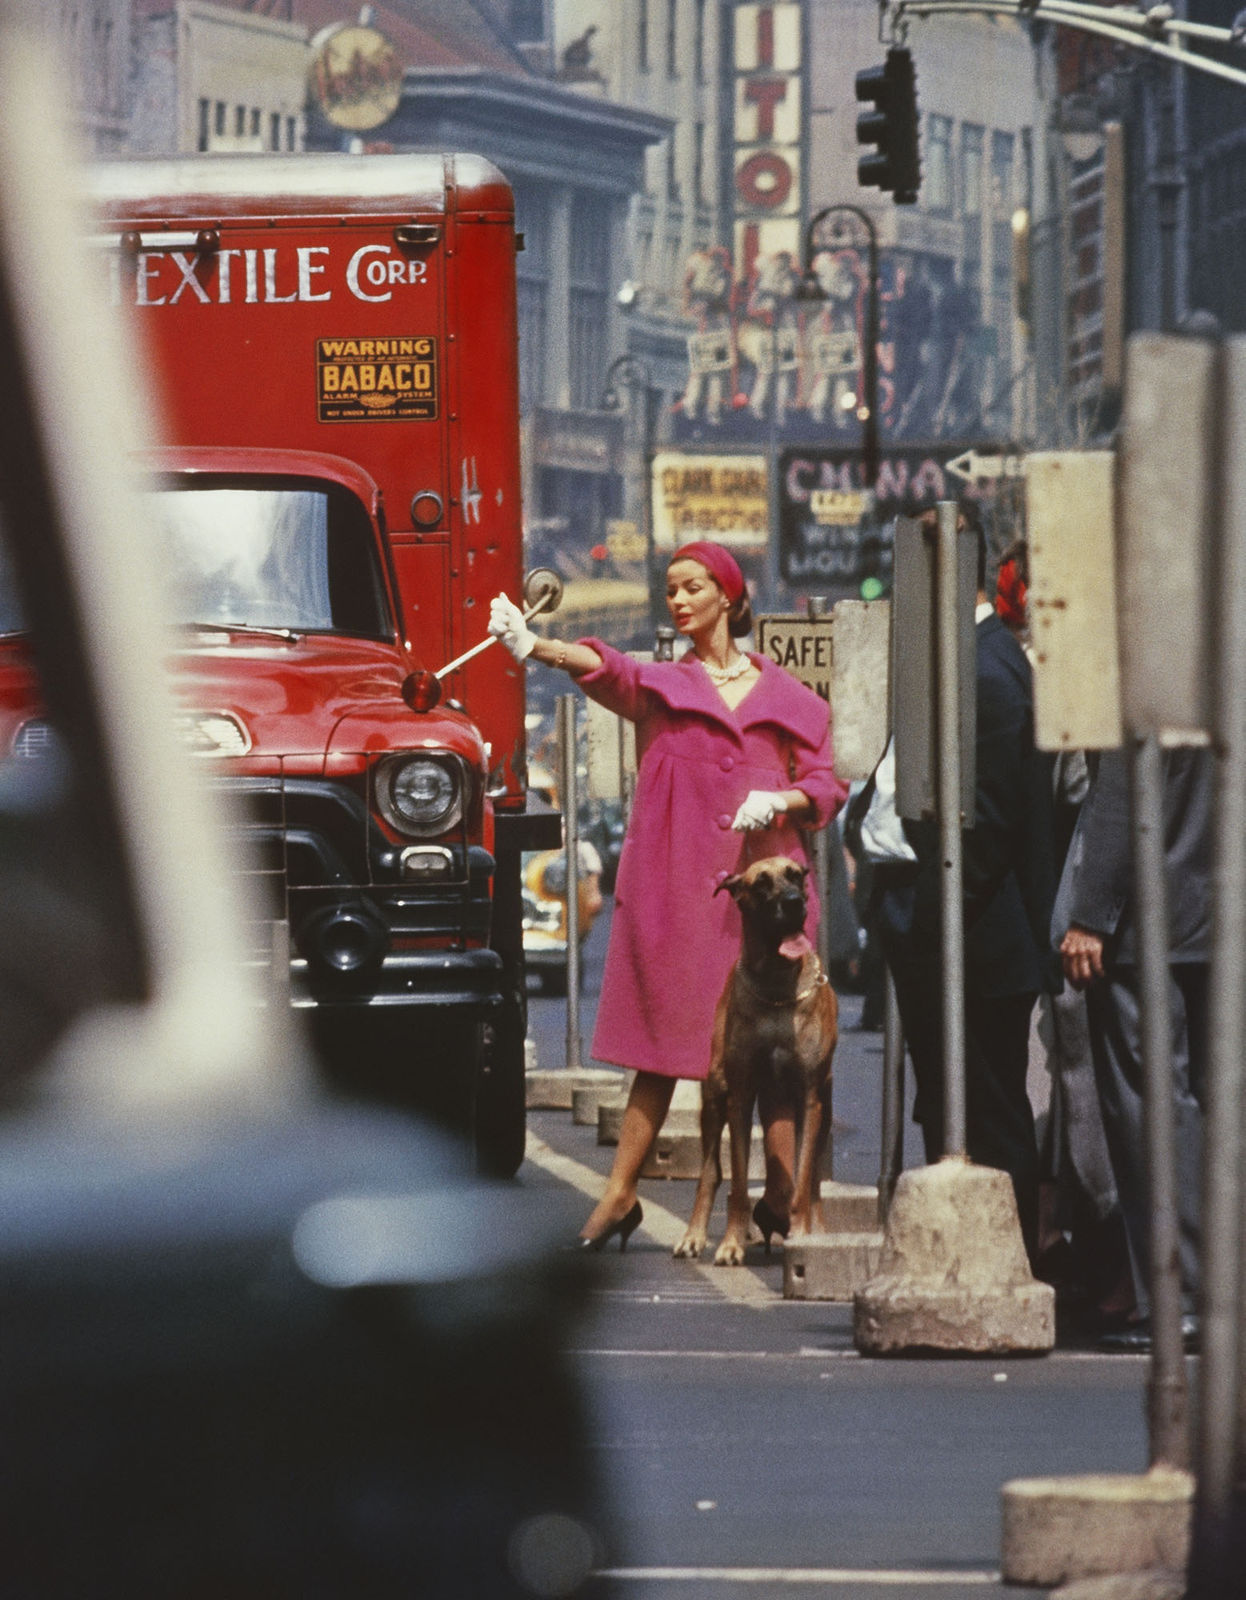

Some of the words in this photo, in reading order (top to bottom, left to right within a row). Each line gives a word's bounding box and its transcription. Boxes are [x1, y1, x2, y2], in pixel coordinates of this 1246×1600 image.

[345, 244, 428, 303] CORP.
[322, 340, 431, 356] WARNING
[323, 364, 431, 392] BABACO
